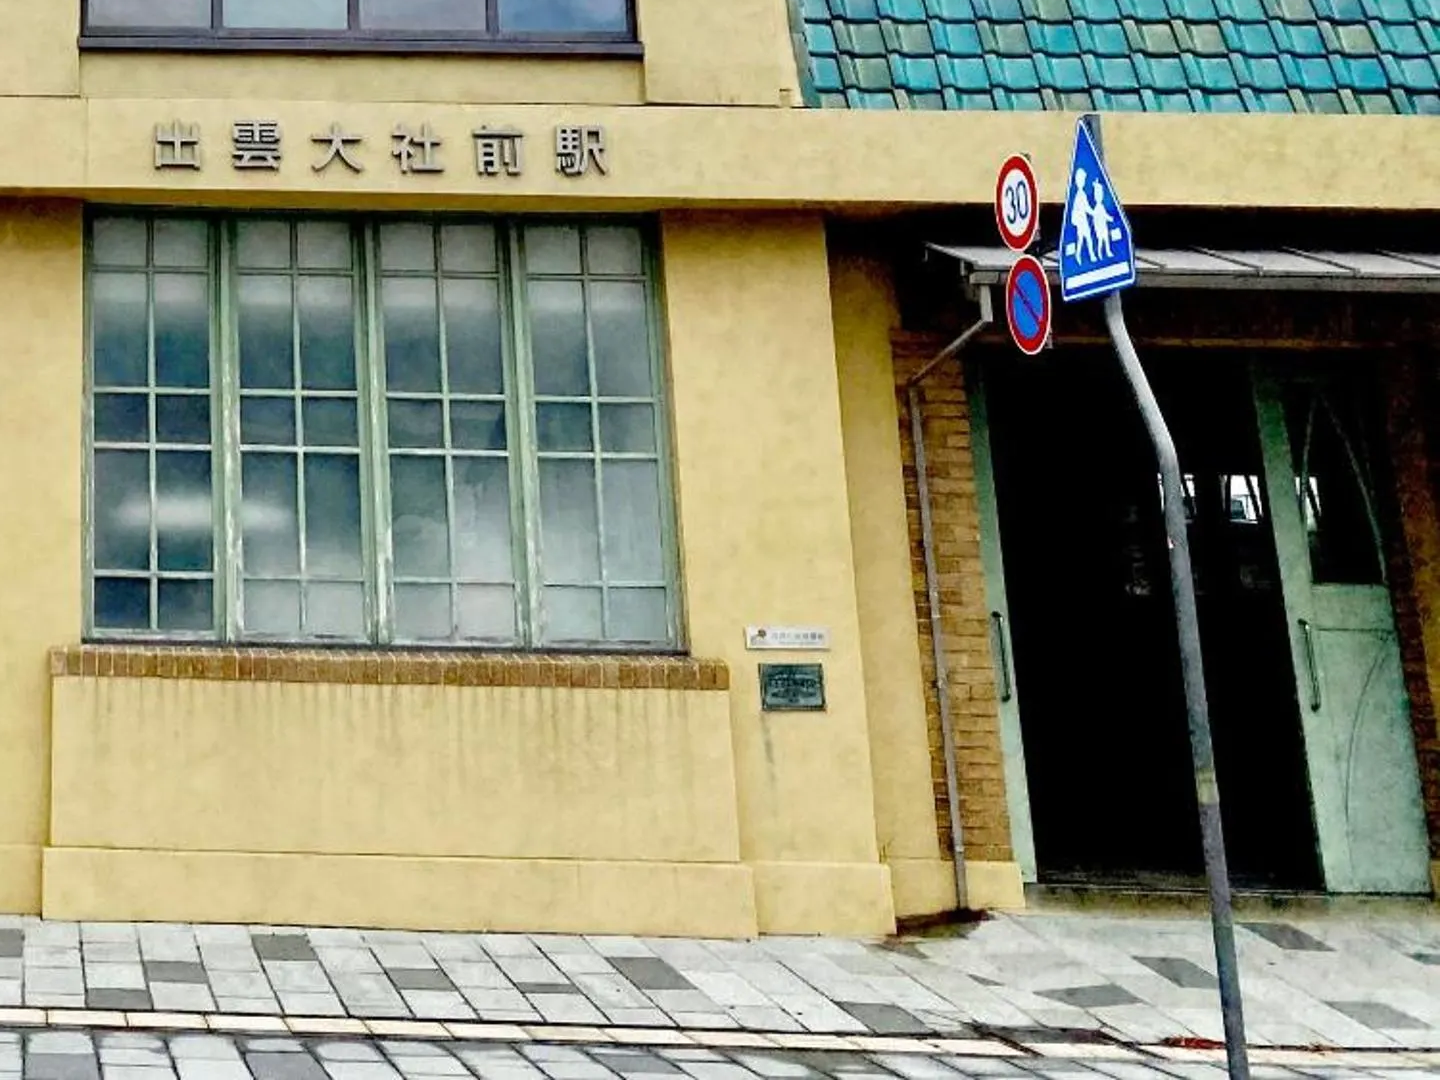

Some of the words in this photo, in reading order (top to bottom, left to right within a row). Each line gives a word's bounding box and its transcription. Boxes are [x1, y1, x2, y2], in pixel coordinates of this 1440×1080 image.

[153, 119, 607, 176] 出雲大社前駅
[1005, 181, 1028, 224] 30
